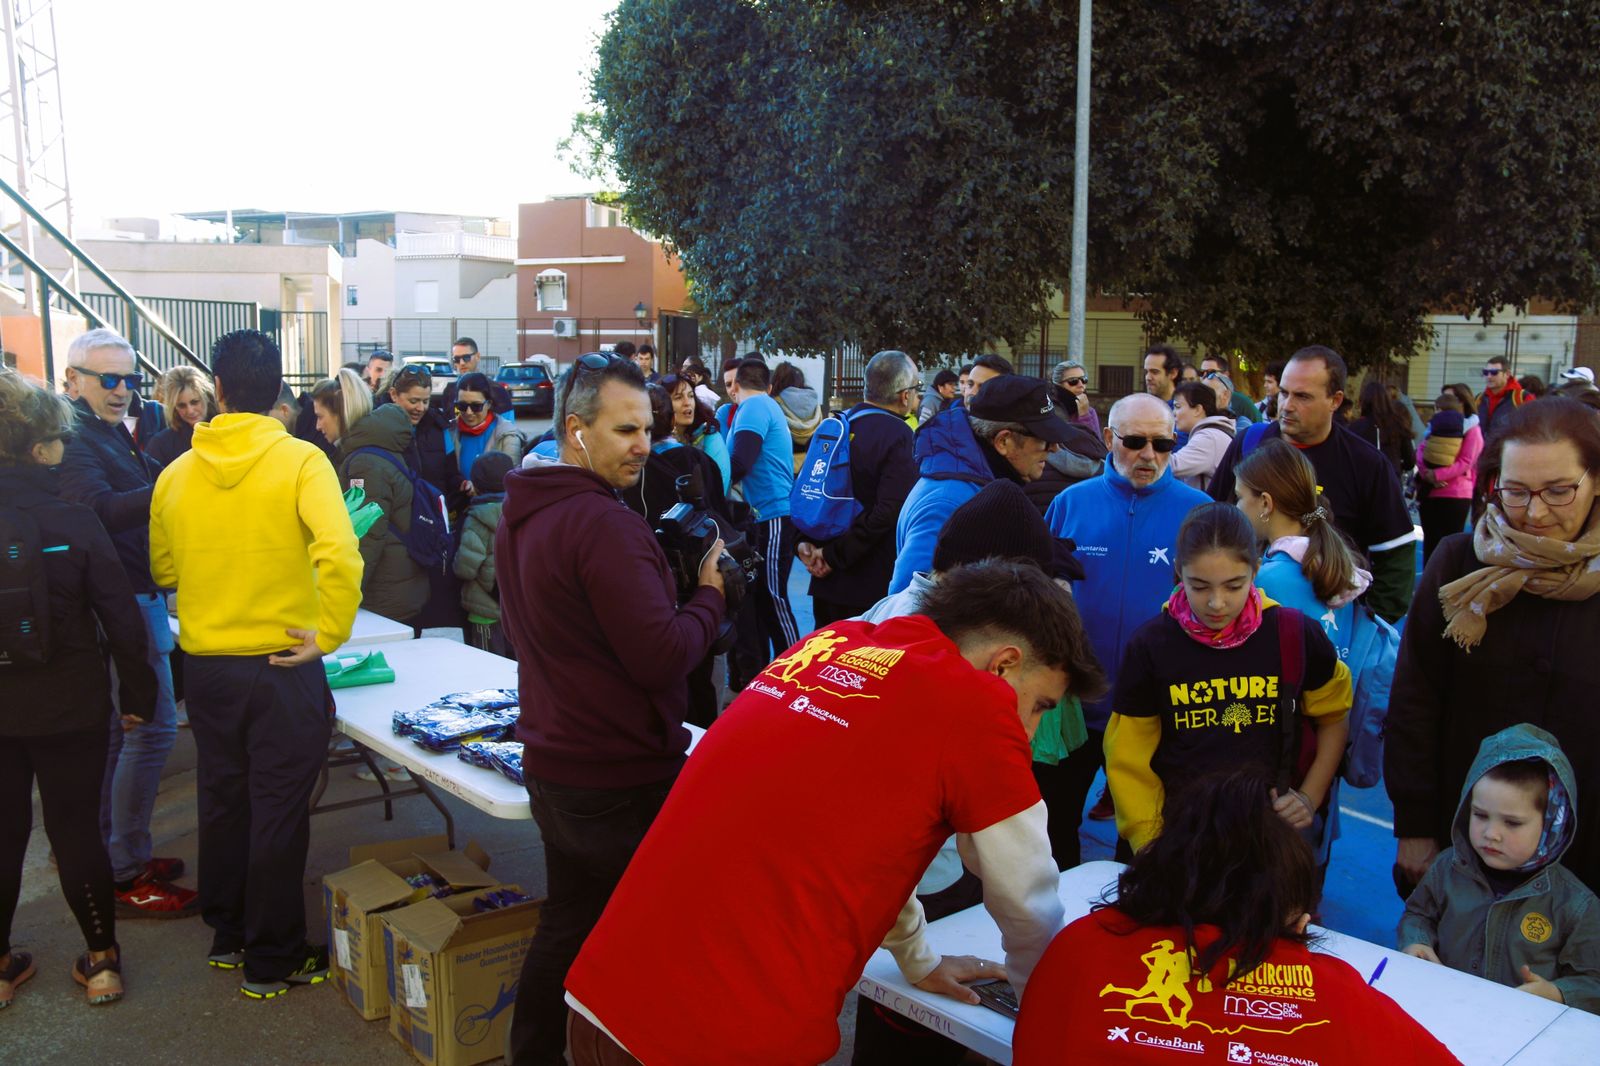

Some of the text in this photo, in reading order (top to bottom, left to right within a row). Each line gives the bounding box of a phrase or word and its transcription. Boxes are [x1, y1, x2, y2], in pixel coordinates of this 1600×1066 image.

[836, 653, 890, 676] PLOGGING
[1226, 981, 1316, 998] PLOGGING
[1282, 1002, 1299, 1010] FUN
[907, 1004, 957, 1037] MOTRIL
[1134, 1031, 1205, 1052] CaixaBank
